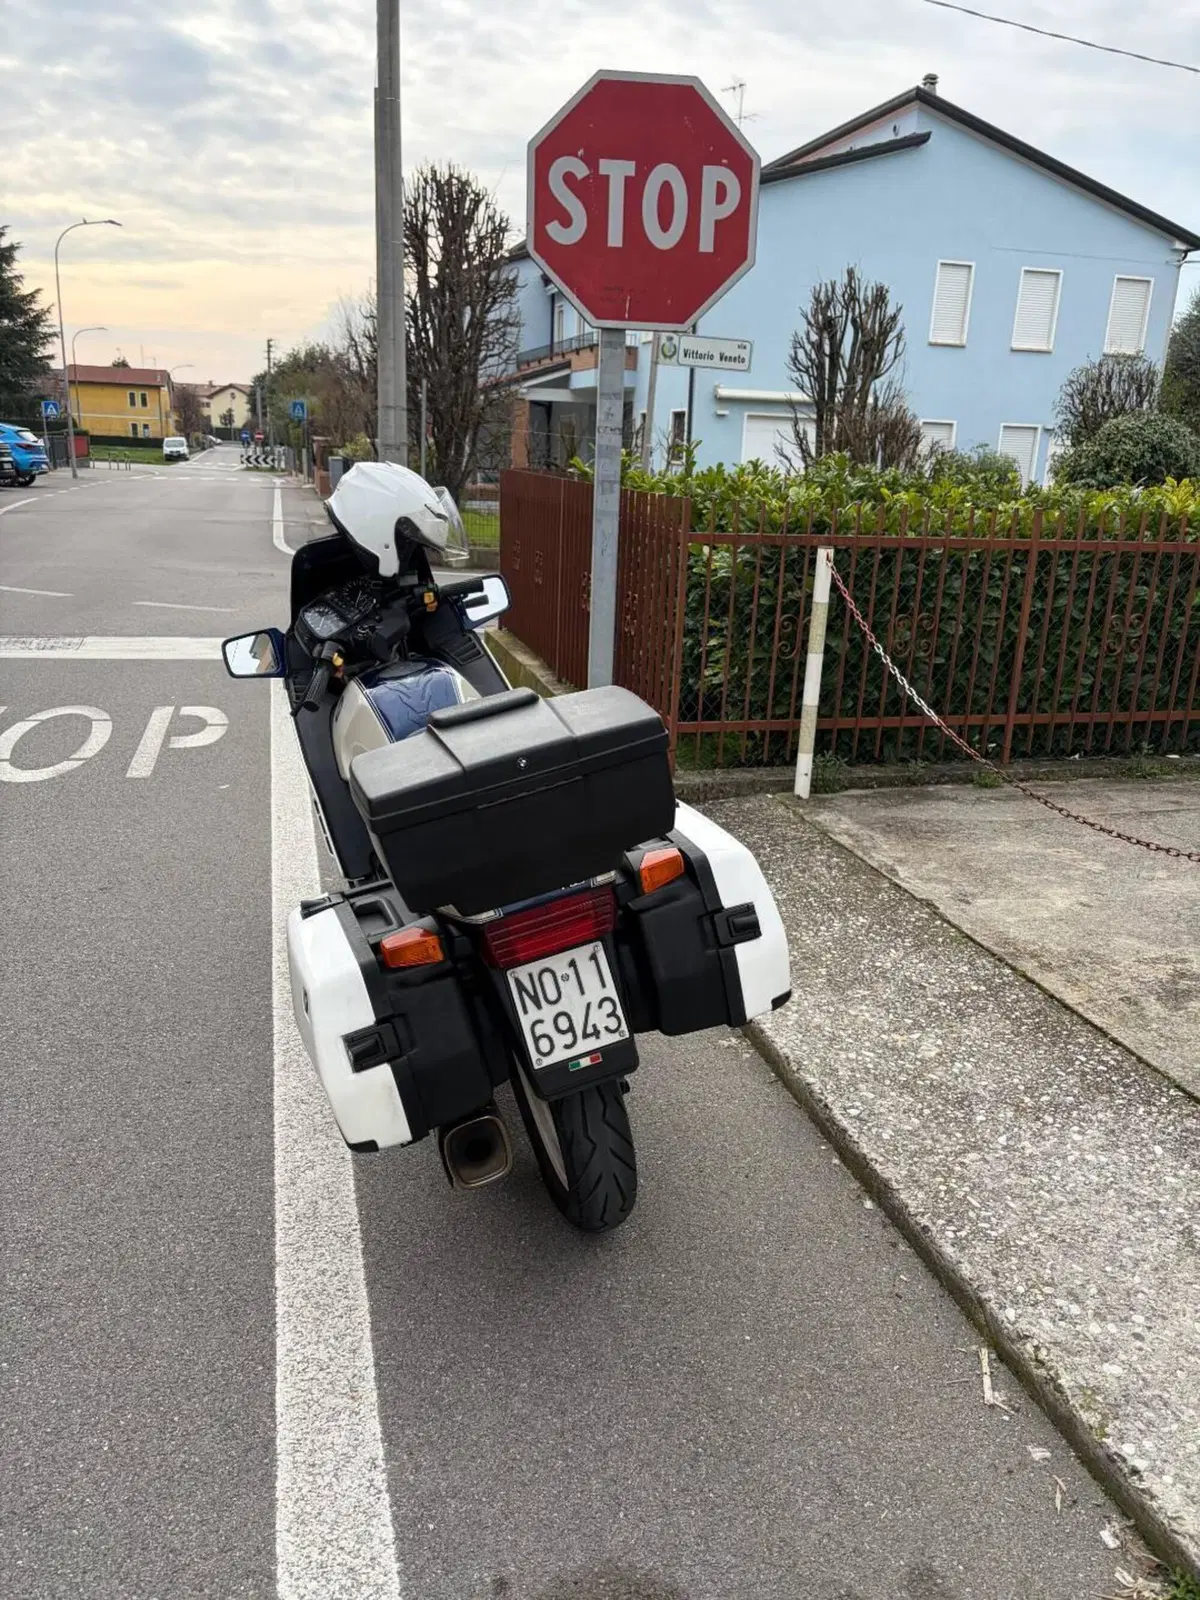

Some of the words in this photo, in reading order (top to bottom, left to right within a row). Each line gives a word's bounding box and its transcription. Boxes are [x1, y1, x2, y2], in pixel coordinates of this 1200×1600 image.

[545, 156, 742, 253] STOP
[683, 348, 715, 361] Vittorio
[719, 351, 746, 364] Veneto
[0, 704, 229, 783] OP
[513, 966, 562, 1015] NO
[568, 951, 607, 995] 11
[530, 996, 622, 1057] 6943
